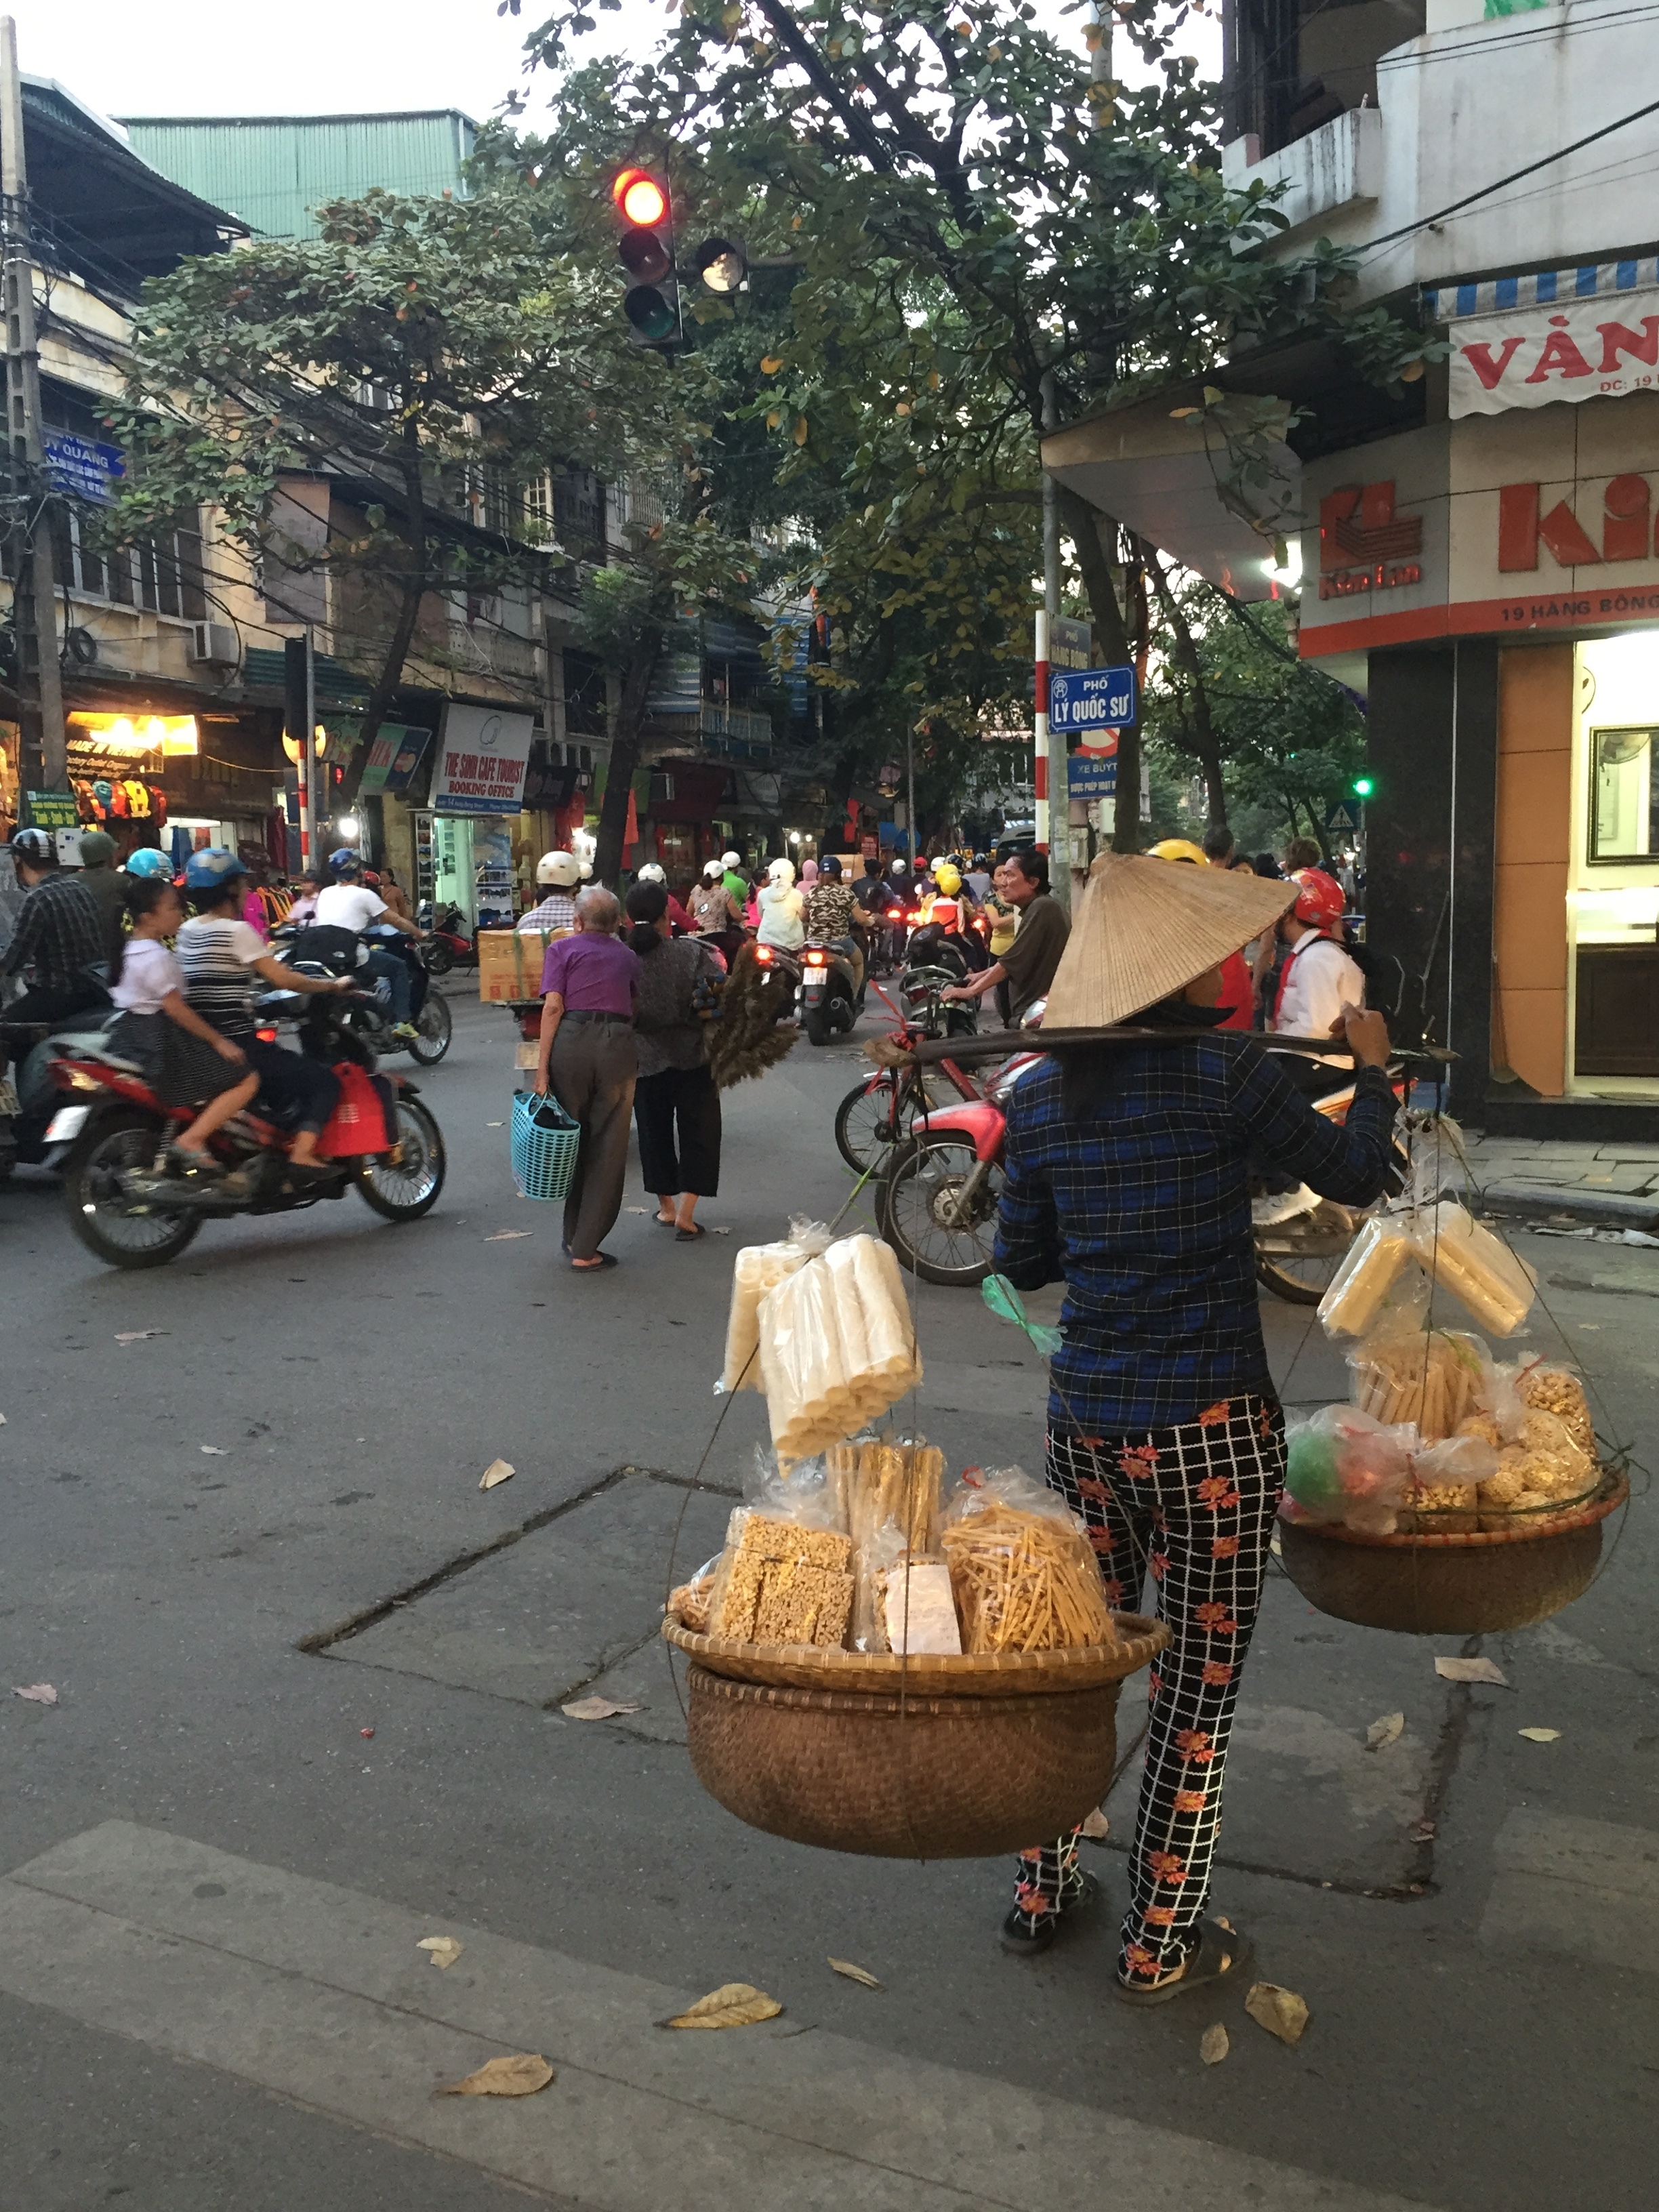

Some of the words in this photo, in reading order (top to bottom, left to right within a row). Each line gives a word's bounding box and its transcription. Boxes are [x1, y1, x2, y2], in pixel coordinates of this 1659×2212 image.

[1634, 375, 1652, 388] 19
[62, 444, 108, 468] QUANG
[1498, 474, 1659, 572] Ki
[1501, 607, 1525, 621] 19
[1531, 600, 1591, 619] HÀNG
[1599, 593, 1659, 613] BÔNG
[1083, 674, 1109, 691] PHỐ
[1054, 698, 1069, 723] LÝ
[1072, 693, 1106, 723] QUỐC
[1109, 693, 1129, 718] SƯ
[66, 739, 96, 752] MADE
[92, 742, 108, 754] IN
[445, 752, 459, 777] THE
[1078, 764, 1090, 774] XE
[1092, 760, 1118, 773] BUÝT
[449, 781, 486, 796] BOOKING
[488, 785, 515, 798] OFFICE
